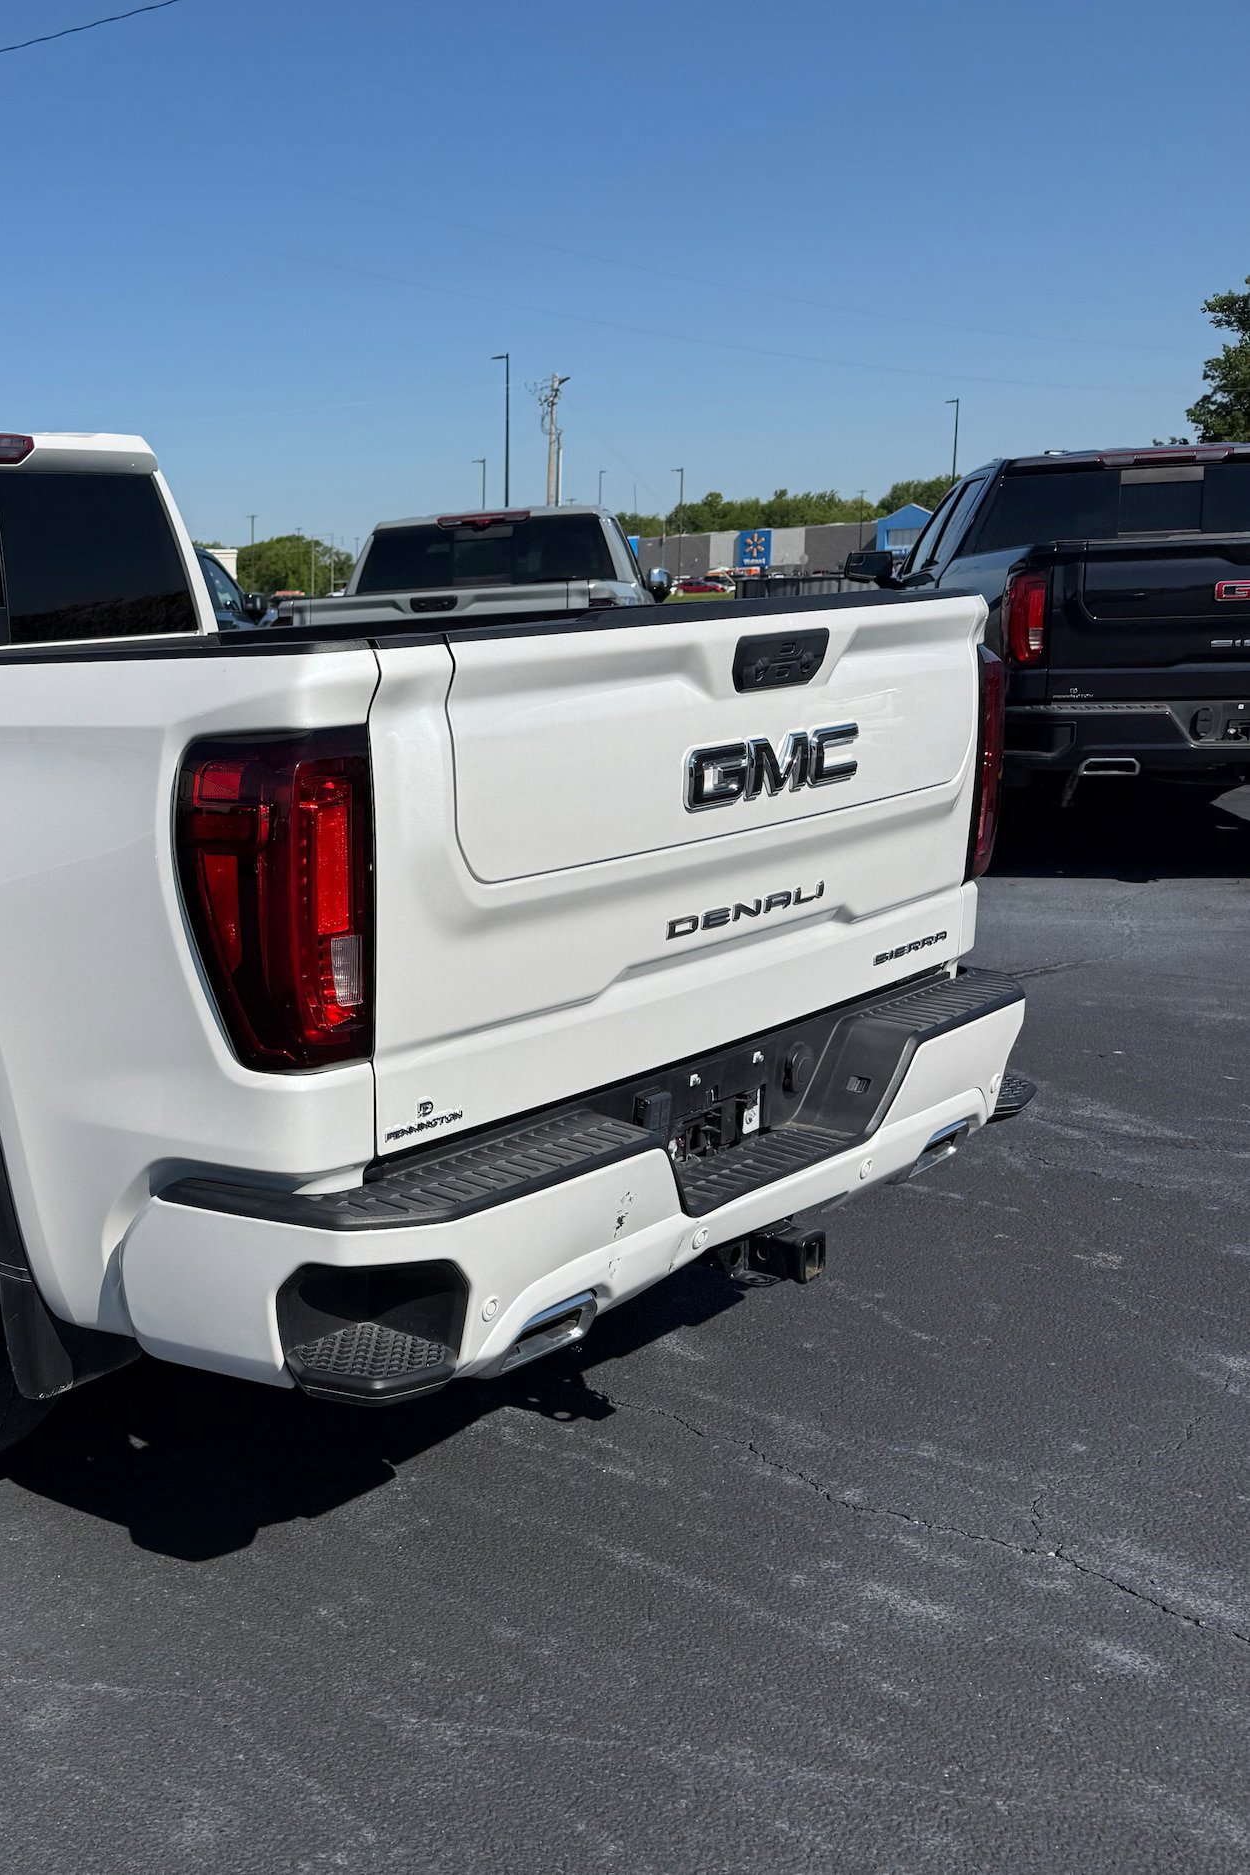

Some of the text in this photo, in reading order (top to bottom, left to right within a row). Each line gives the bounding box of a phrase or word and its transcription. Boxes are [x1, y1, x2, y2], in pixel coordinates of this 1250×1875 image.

[682, 721, 859, 814] GMC
[665, 879, 825, 941] DENALI
[872, 930, 948, 967] SIERRA
[384, 1110, 464, 1143] PENNINGTON
